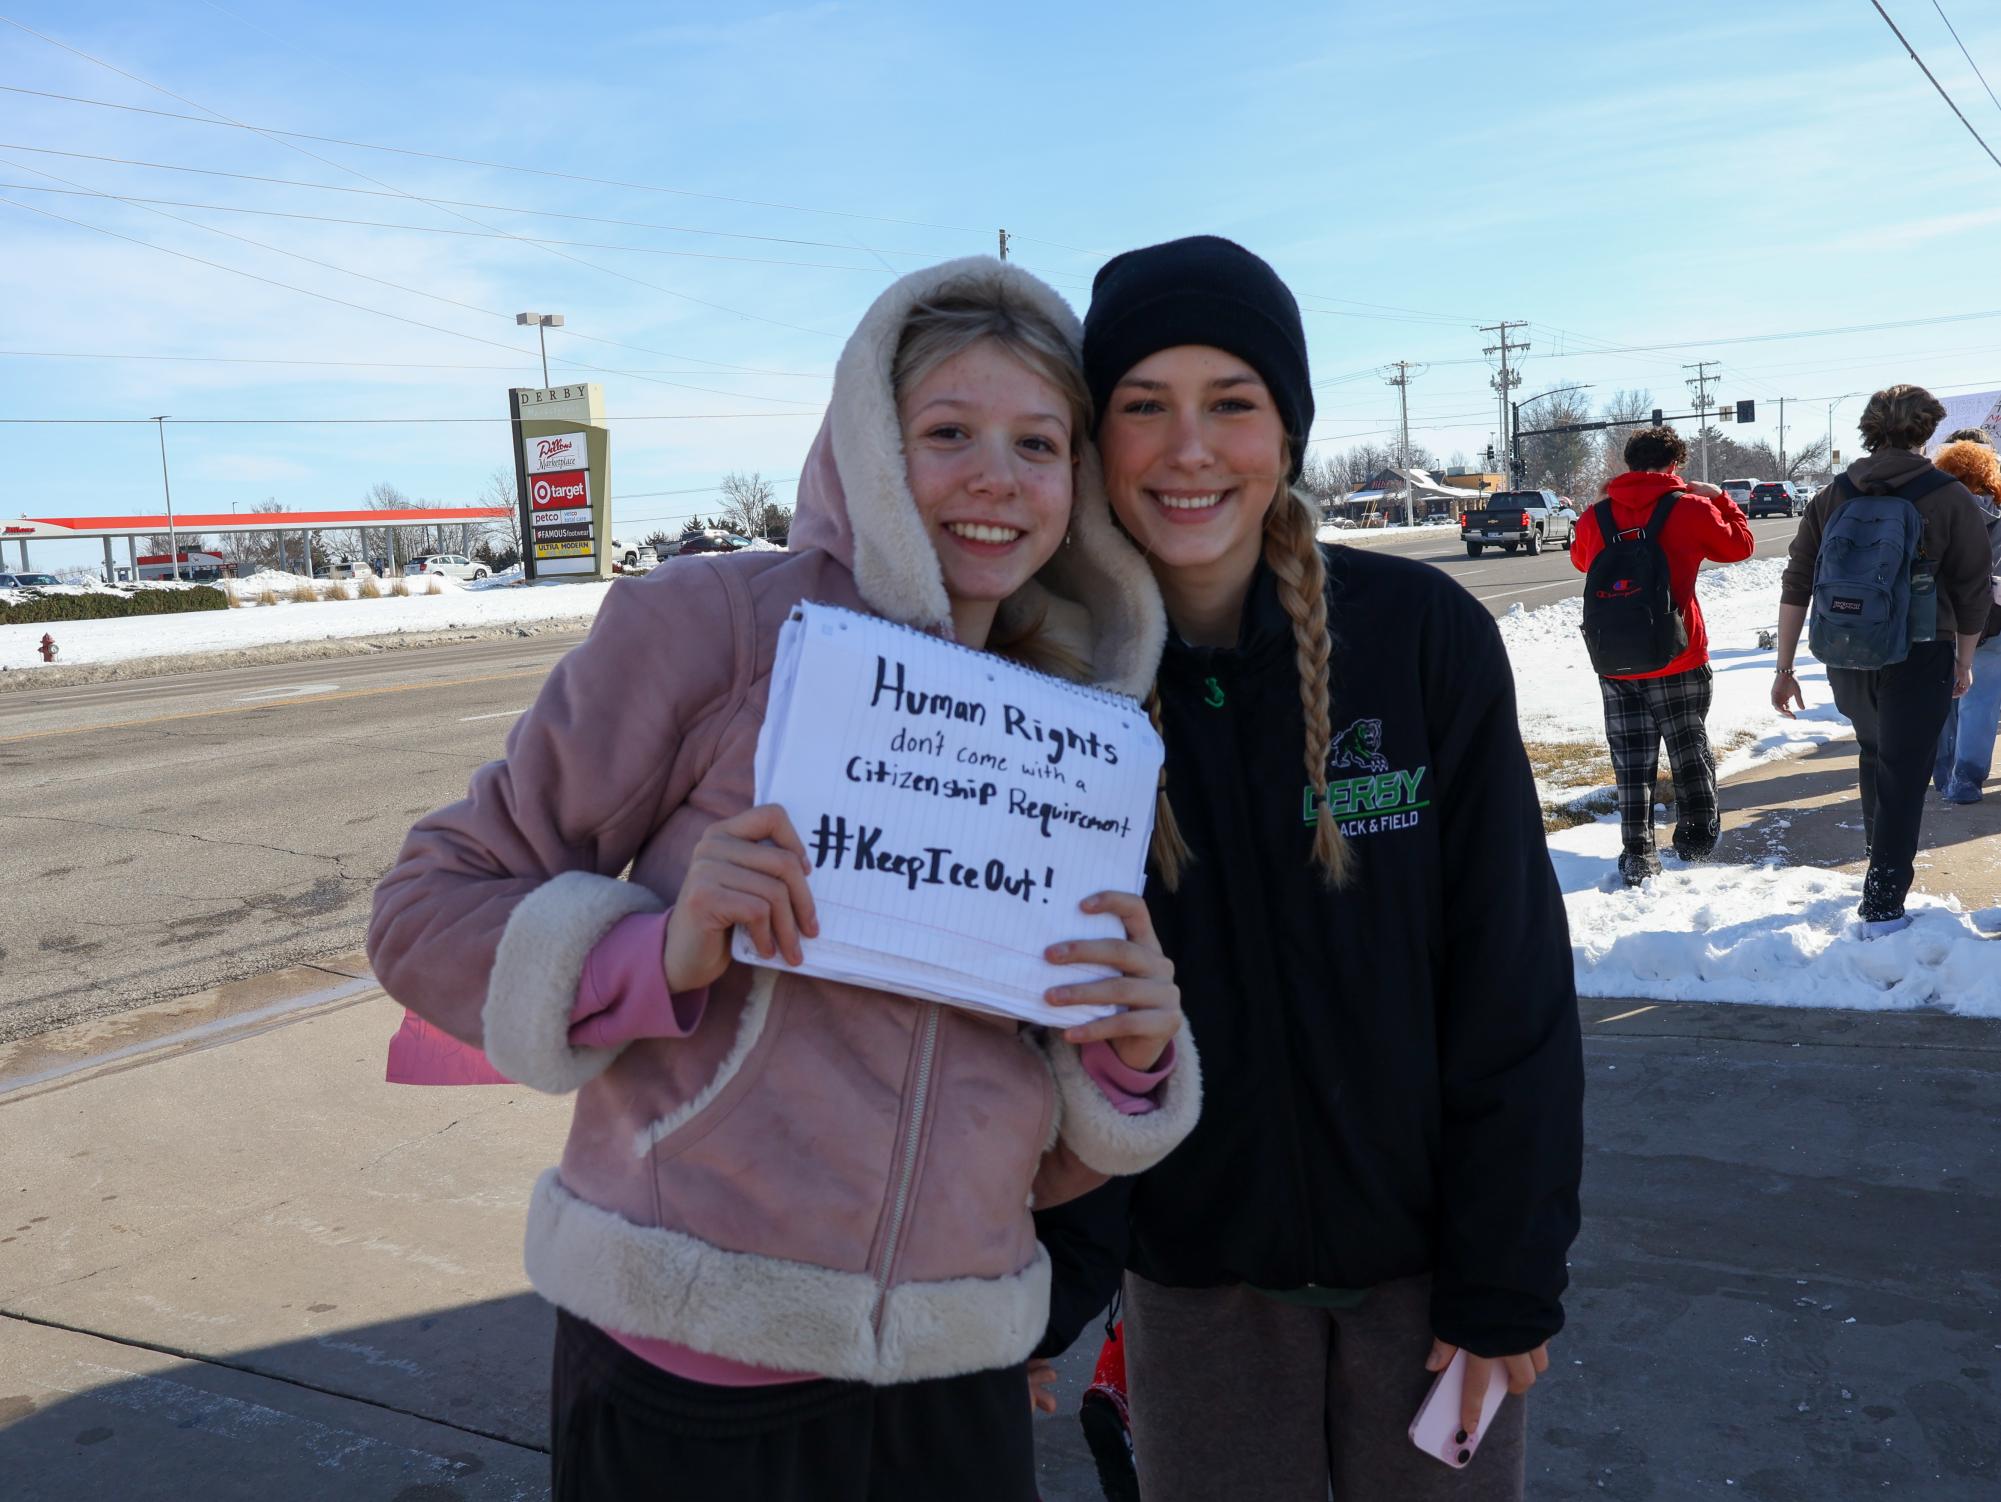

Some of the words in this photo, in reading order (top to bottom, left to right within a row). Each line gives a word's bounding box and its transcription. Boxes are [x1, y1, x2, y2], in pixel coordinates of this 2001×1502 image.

[521, 386, 585, 405] DERBY
[537, 438, 573, 459] Dillons
[537, 457, 576, 471] Marketplace
[551, 482, 584, 499] target
[535, 512, 559, 524] petco
[542, 529, 567, 539] FAMOUS
[538, 543, 559, 551] ULTRA
[561, 541, 589, 550] MODERN
[871, 655, 986, 726] Human
[1004, 705, 1118, 765] Rights
[891, 728, 945, 757] don't
[957, 747, 1007, 771] come
[1022, 761, 1066, 784] with
[1075, 779, 1087, 793] a
[846, 756, 997, 806] Citizenship
[1008, 788, 1132, 838] Requirement
[1340, 820, 1368, 837] ACK
[1369, 819, 1379, 833] &
[1381, 811, 1419, 832] FIELD
